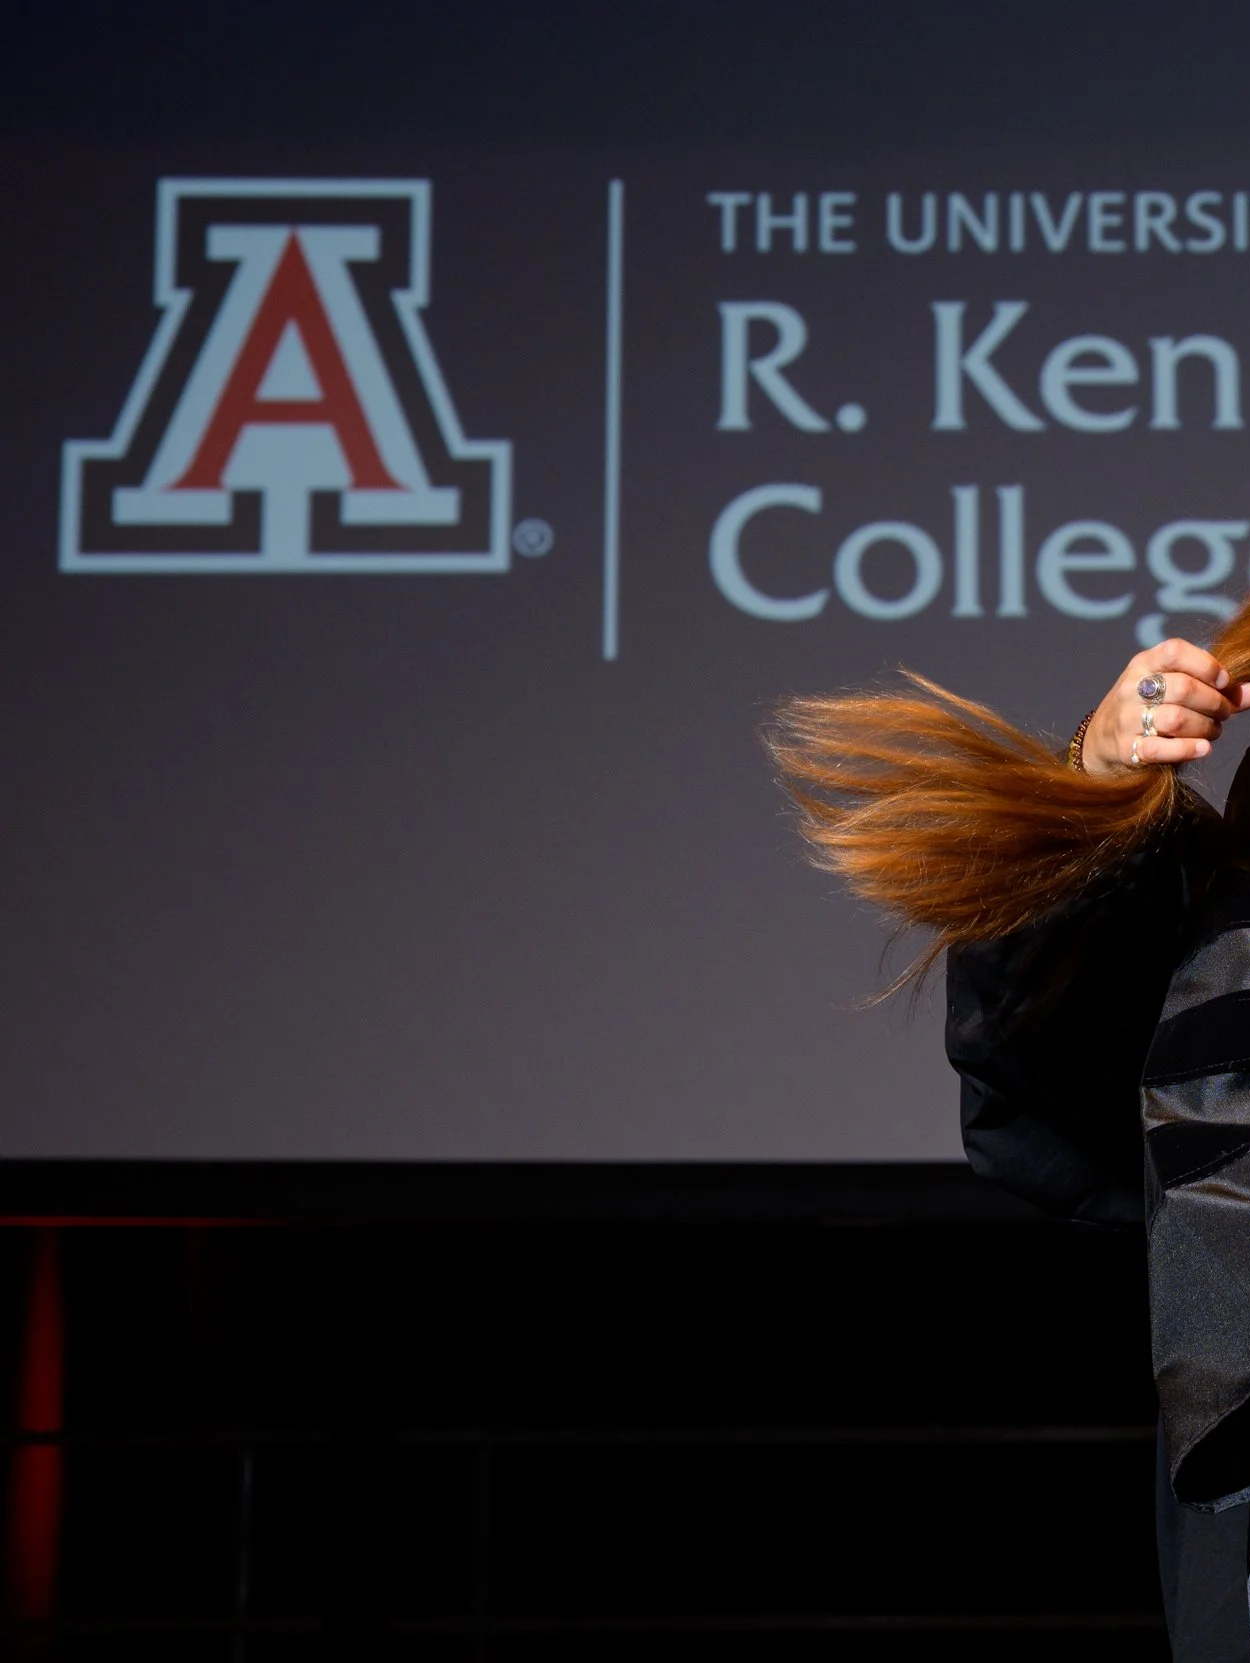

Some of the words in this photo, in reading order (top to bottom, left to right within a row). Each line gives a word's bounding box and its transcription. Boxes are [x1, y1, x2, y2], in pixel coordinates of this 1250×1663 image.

[707, 191, 857, 254] THE
[717, 300, 867, 433] R.
[930, 300, 1245, 433] Ken
